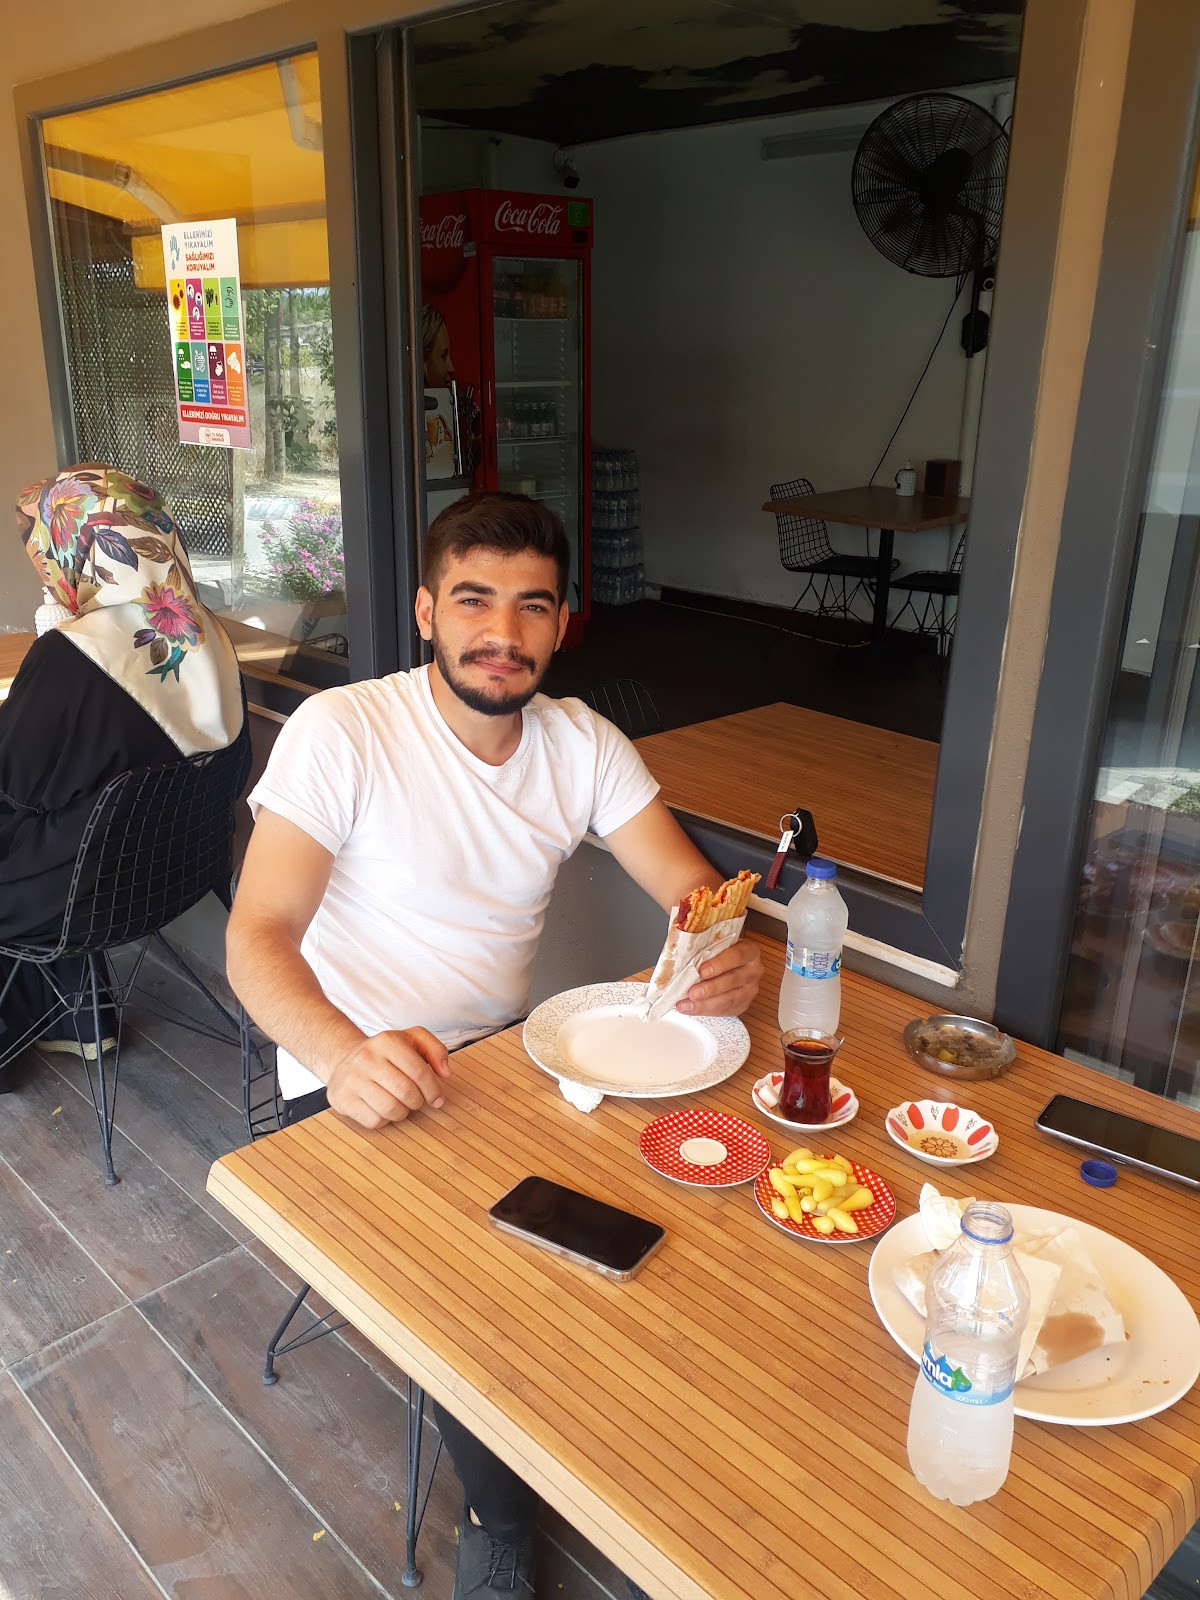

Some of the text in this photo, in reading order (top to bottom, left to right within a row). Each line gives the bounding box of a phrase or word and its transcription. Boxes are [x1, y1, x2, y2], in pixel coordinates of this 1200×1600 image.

[494, 200, 564, 235] Coca-Cola
[183, 228, 213, 240] ELLERİMİZİ
[184, 240, 214, 249] YIKAYALIM
[185, 251, 215, 262] SAĞLIĞIMIZI
[186, 263, 215, 272] KORUYALIM
[182, 409, 204, 420] ELLERİMİZİ
[205, 410, 221, 421] DOĞRU
